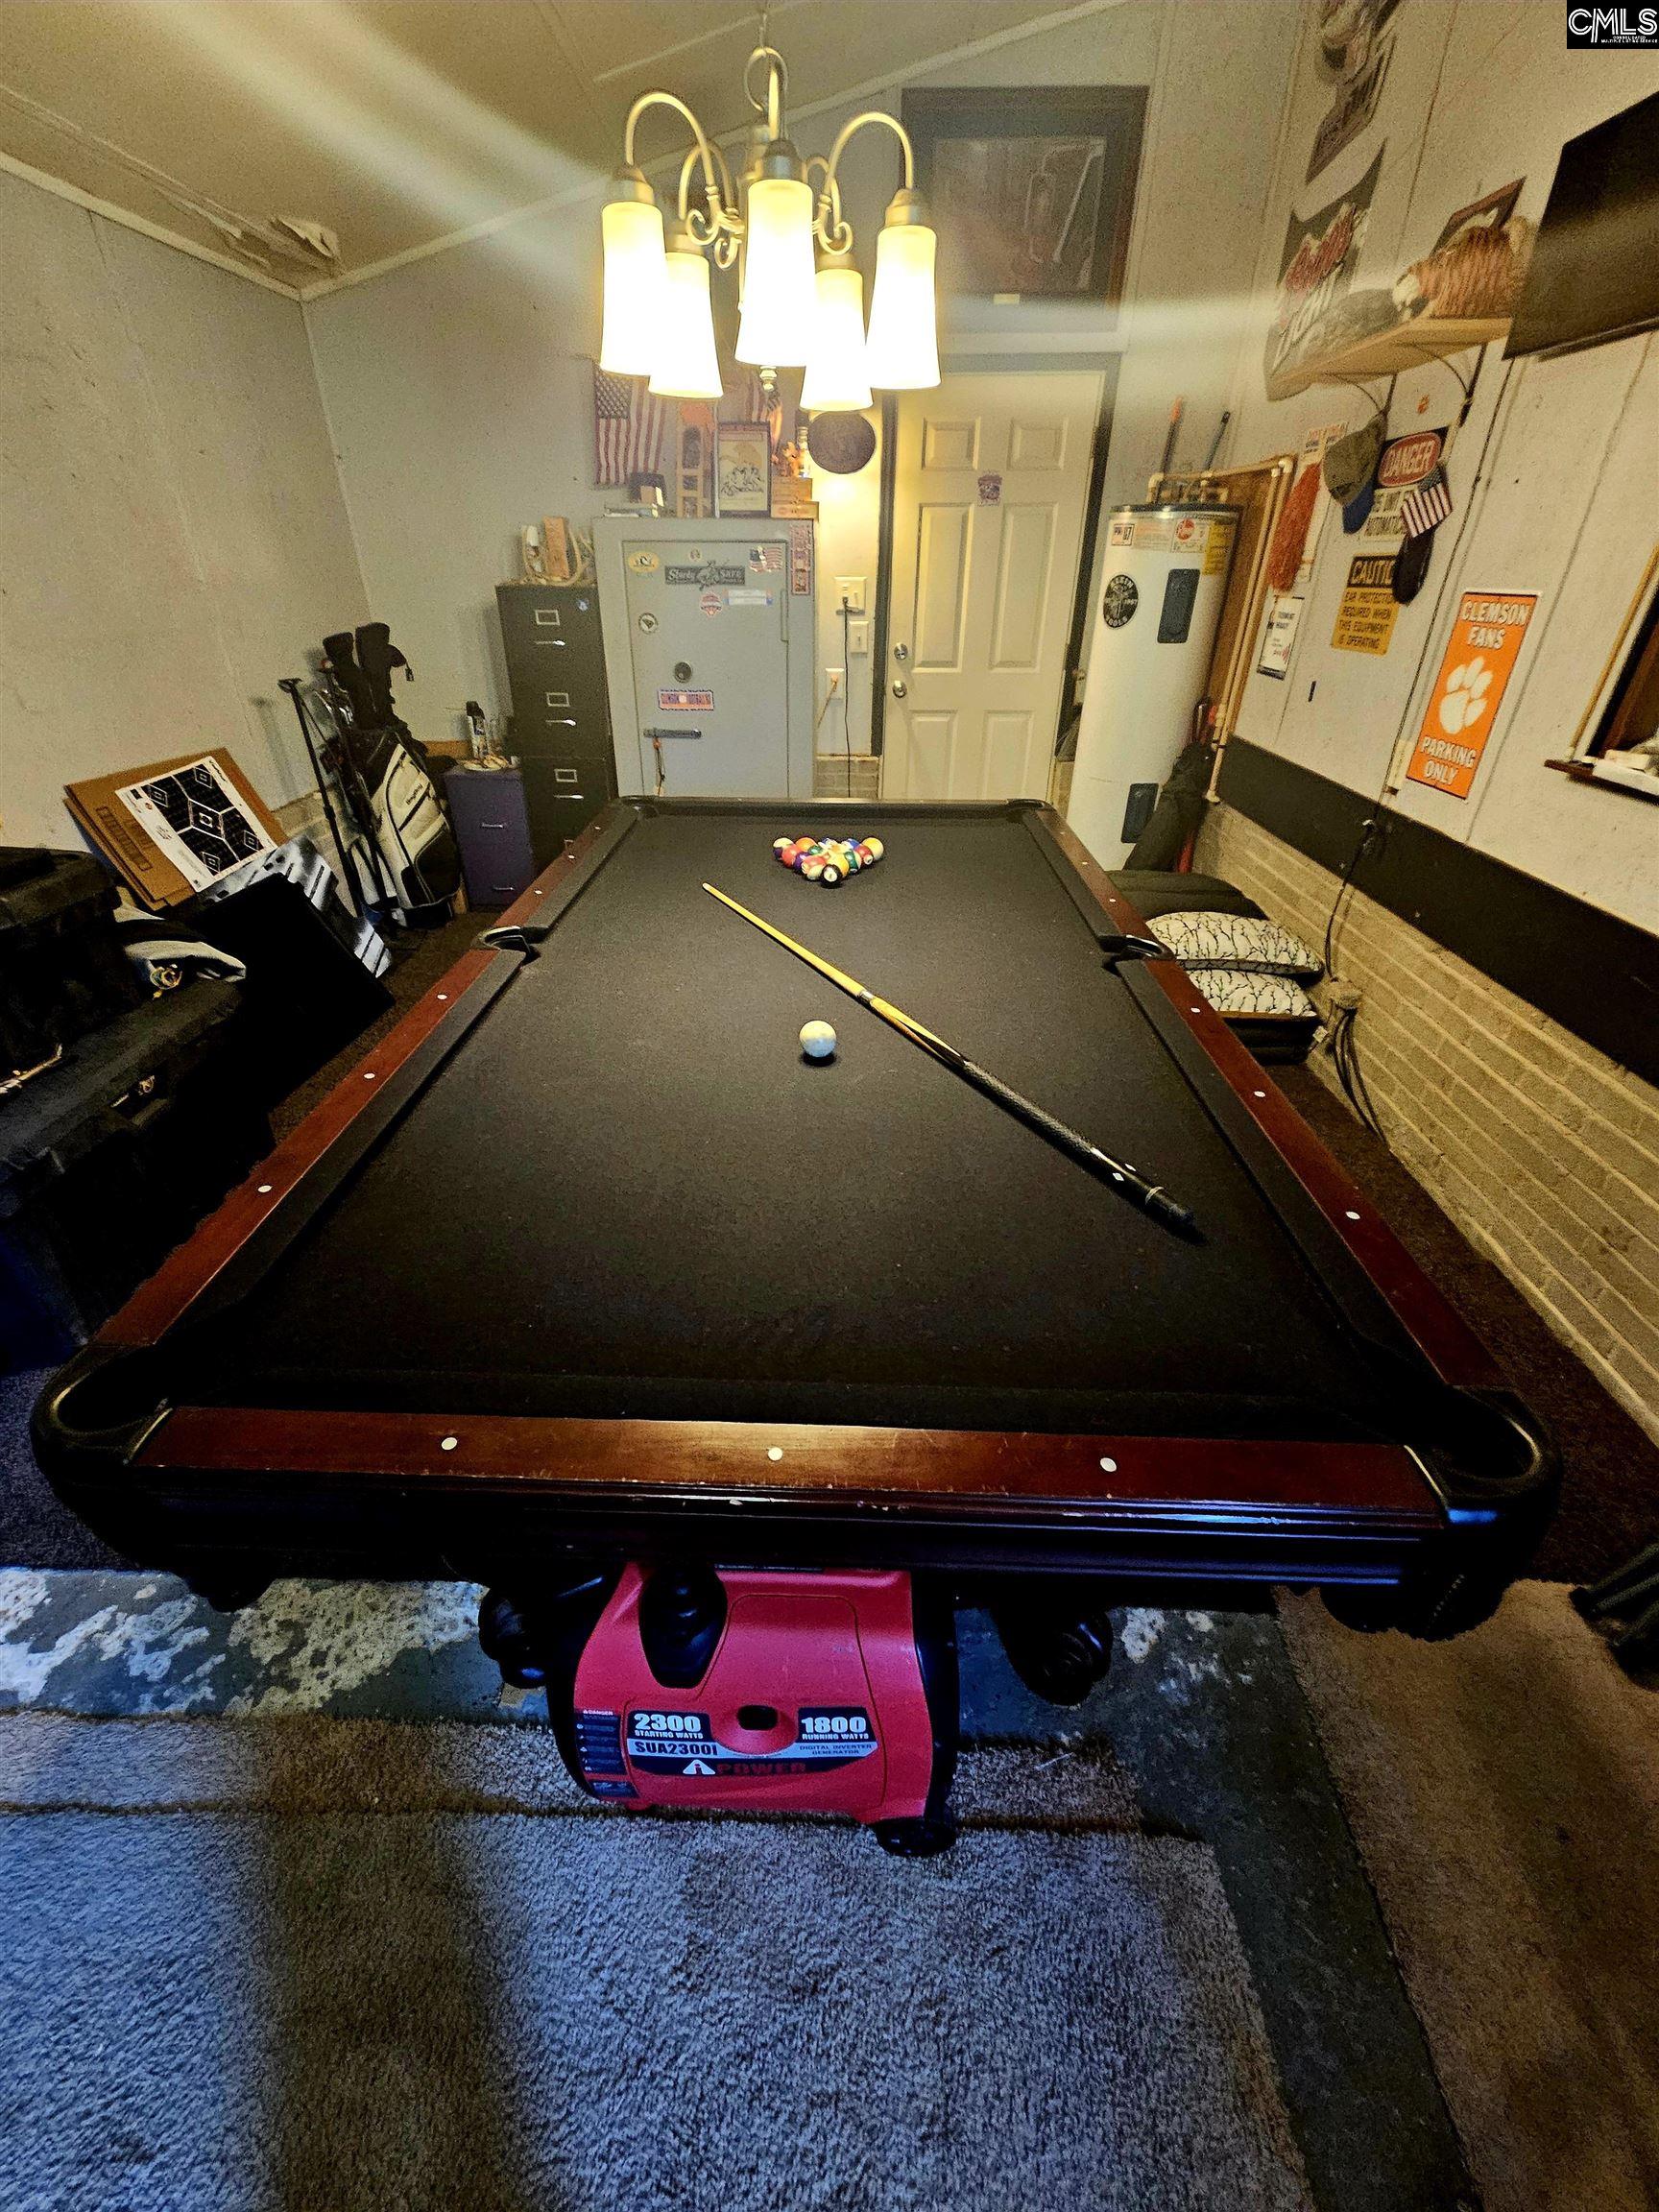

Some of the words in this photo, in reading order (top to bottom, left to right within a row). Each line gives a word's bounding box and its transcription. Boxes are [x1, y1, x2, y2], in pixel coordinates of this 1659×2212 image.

[1383, 439, 1437, 479] DANGER
[1350, 559, 1397, 585] CAUTIO
[1358, 591, 1397, 605] PROTECTIO
[1459, 599, 1529, 626] CLEMSON
[1466, 626, 1507, 650] FANS
[1420, 735, 1478, 768] PARKING
[1425, 759, 1460, 786] ONLY
[634, 1713, 702, 1733] 2300
[635, 1729, 675, 1739] STARTING
[676, 1731, 704, 1740] WATTS
[800, 1716, 867, 1733] 1800
[715, 1762, 806, 1775] POWER
